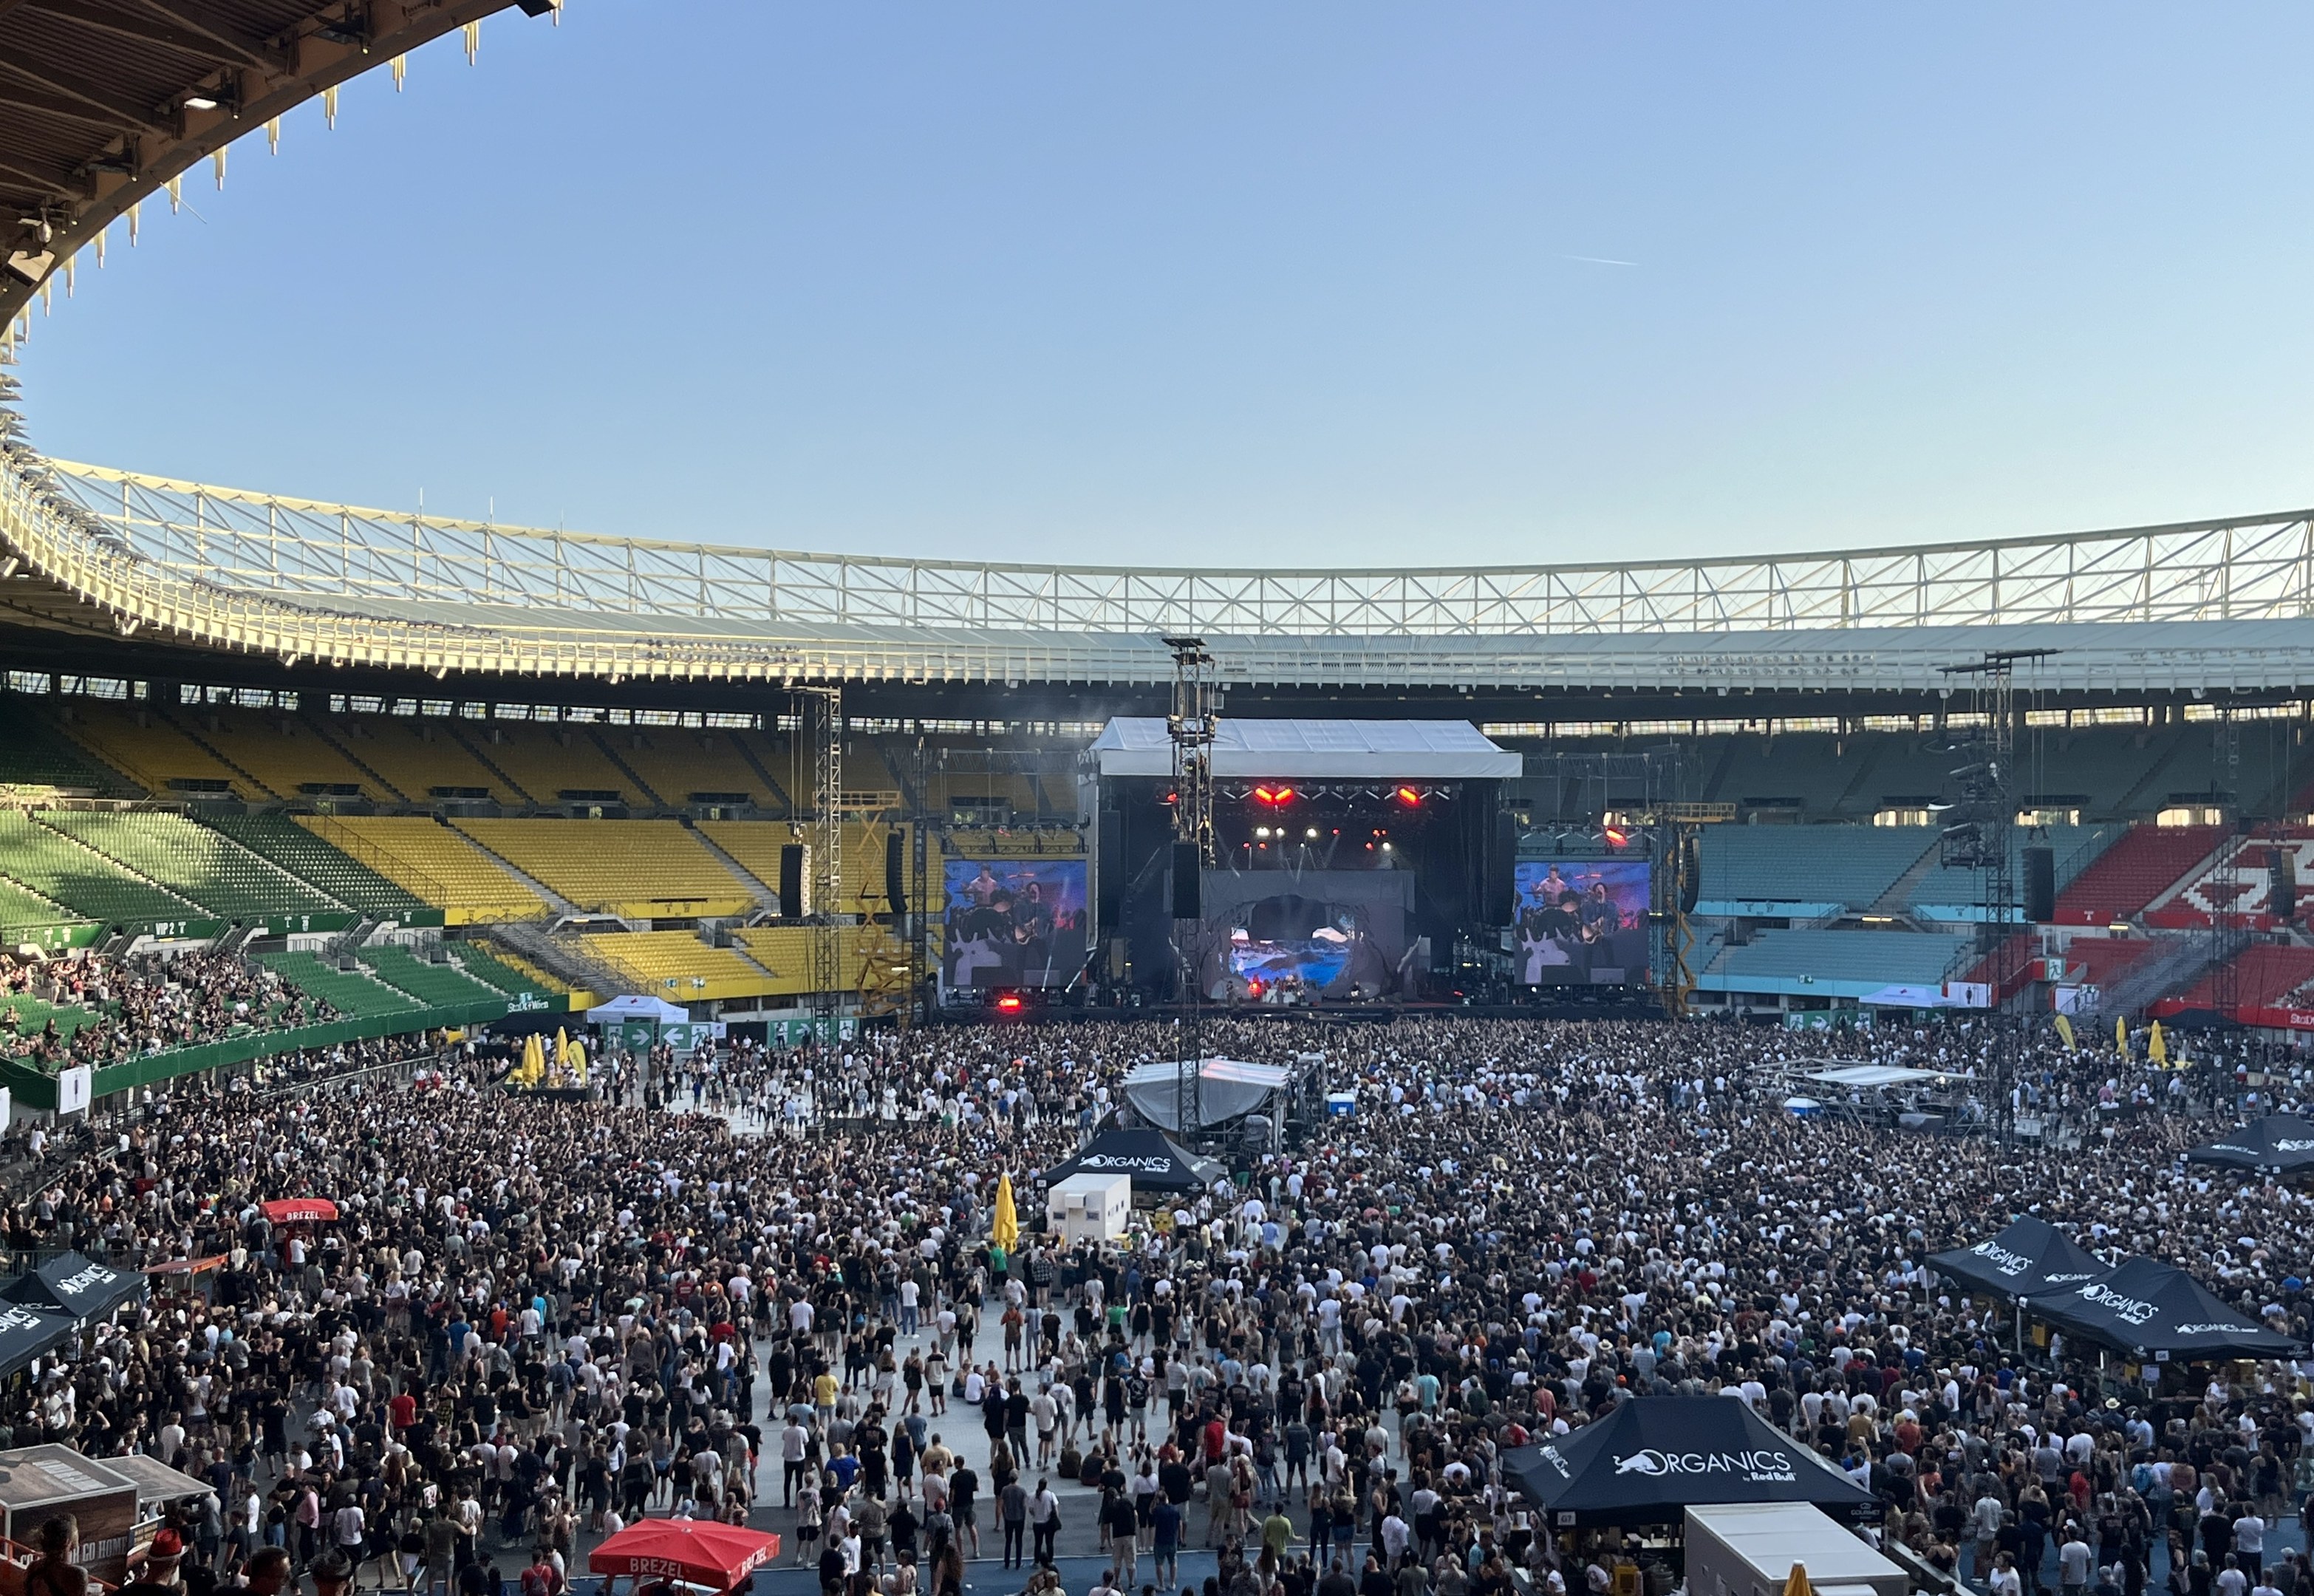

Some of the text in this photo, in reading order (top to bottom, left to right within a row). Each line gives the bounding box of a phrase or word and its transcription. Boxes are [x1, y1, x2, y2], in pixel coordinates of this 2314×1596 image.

[155, 922, 168, 935] VIP
[168, 922, 175, 935] 2
[1094, 1153, 1171, 1168] ORGANICS
[286, 1210, 320, 1221] BREZEL
[1974, 1241, 2033, 1272] ORGANICS
[2081, 1283, 2160, 1320] ORGANICS
[1634, 1449, 1792, 1476] ORGANICS
[1750, 1471, 1774, 1481] Red
[1773, 1471, 1796, 1481] Bull
[82, 1542, 95, 1562] GO
[98, 1537, 128, 1559] HOME
[630, 1558, 684, 1579] BREZEL
